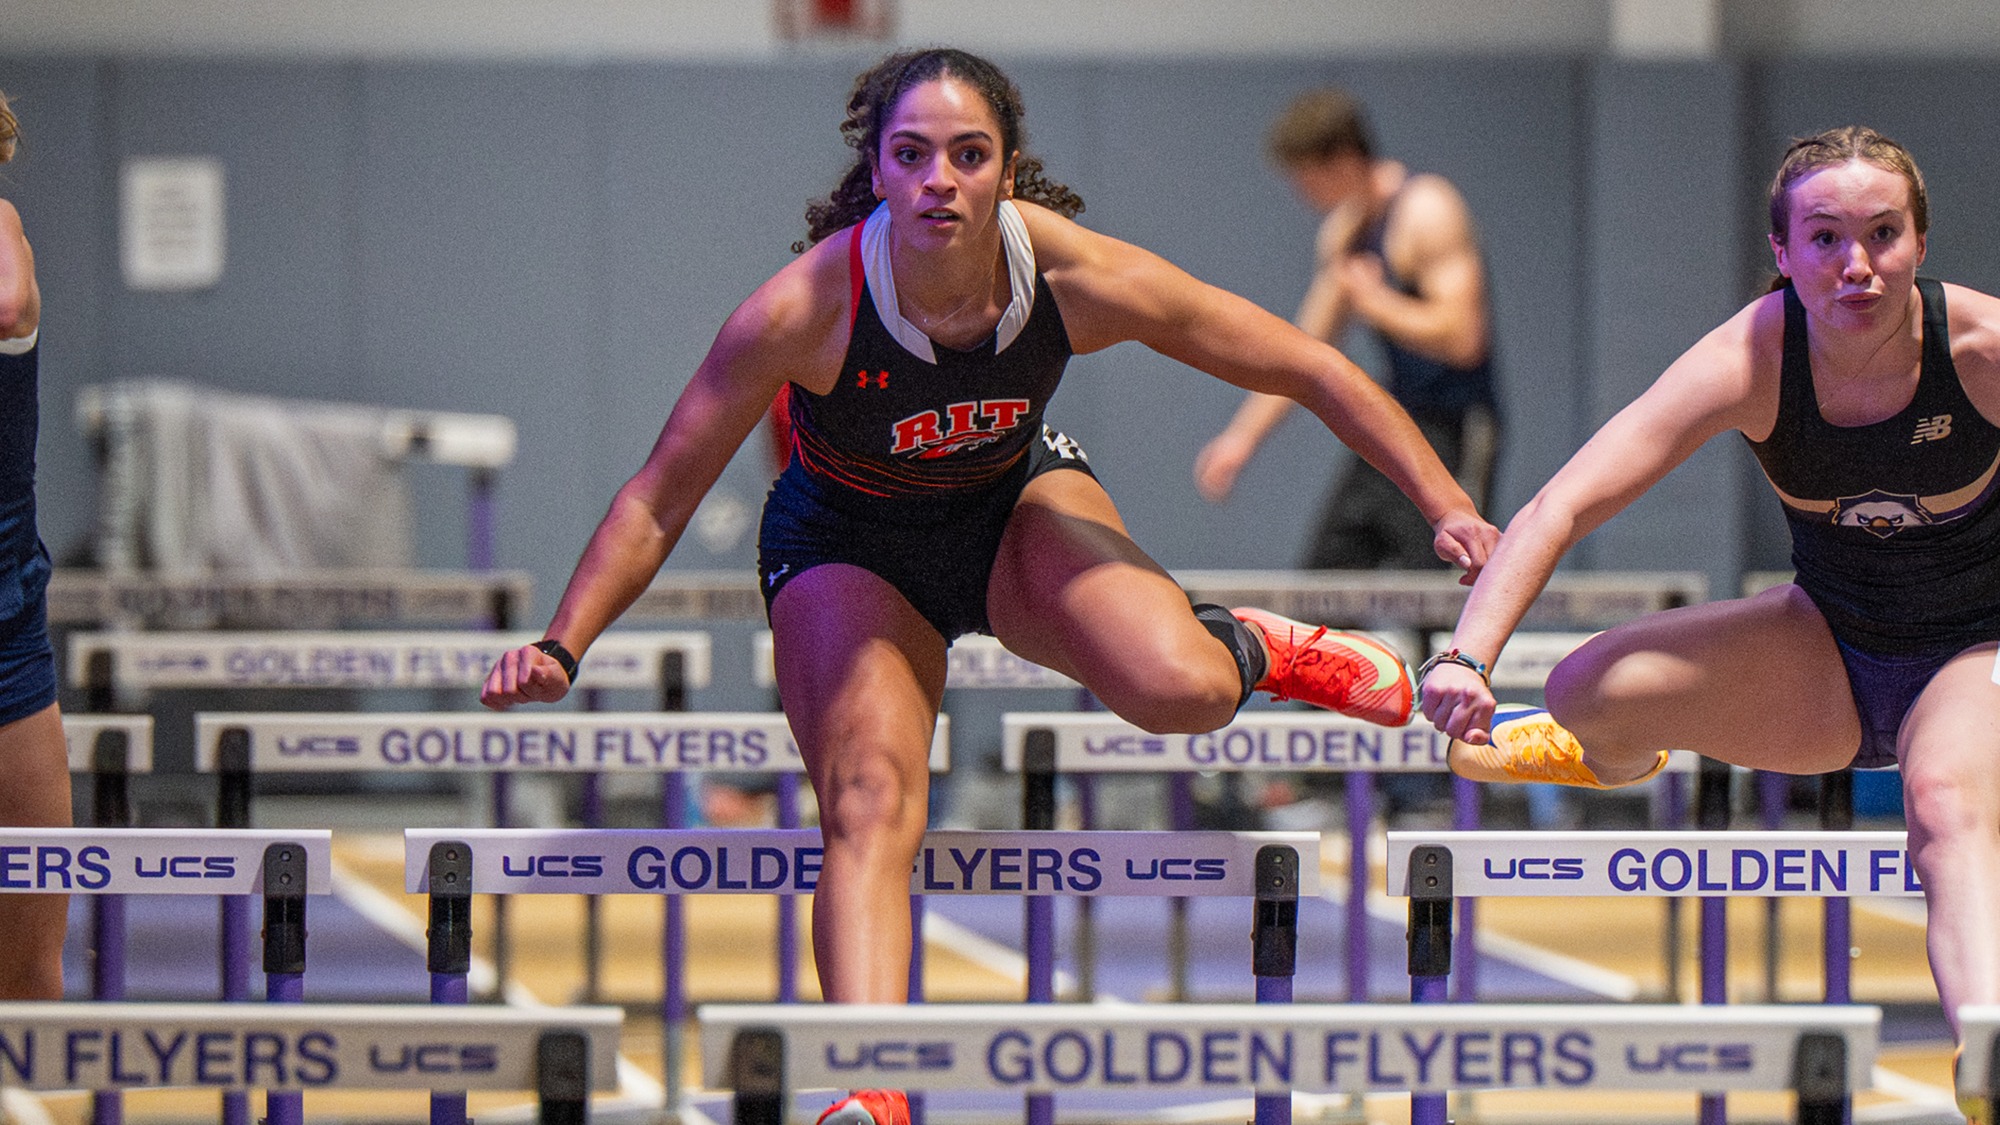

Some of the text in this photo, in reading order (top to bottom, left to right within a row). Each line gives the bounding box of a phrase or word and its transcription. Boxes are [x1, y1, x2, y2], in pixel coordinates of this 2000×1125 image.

[890, 399, 1030, 454] RIT
[380, 728, 576, 765] GOLDEN
[595, 729, 768, 766] FLYERS
[1187, 728, 1383, 765] GOLDEN
[135, 856, 236, 879] UCS
[502, 855, 604, 878] UCS
[912, 848, 1102, 892] LYERS
[1125, 858, 1226, 881] UCS
[1484, 858, 1585, 880] UCS
[1608, 848, 1848, 892] GOLDEN
[65, 1029, 340, 1086] FLYERS
[368, 1043, 497, 1074] UCS
[824, 1028, 1755, 1087] UCS GOLDEN FLYERS UCS
